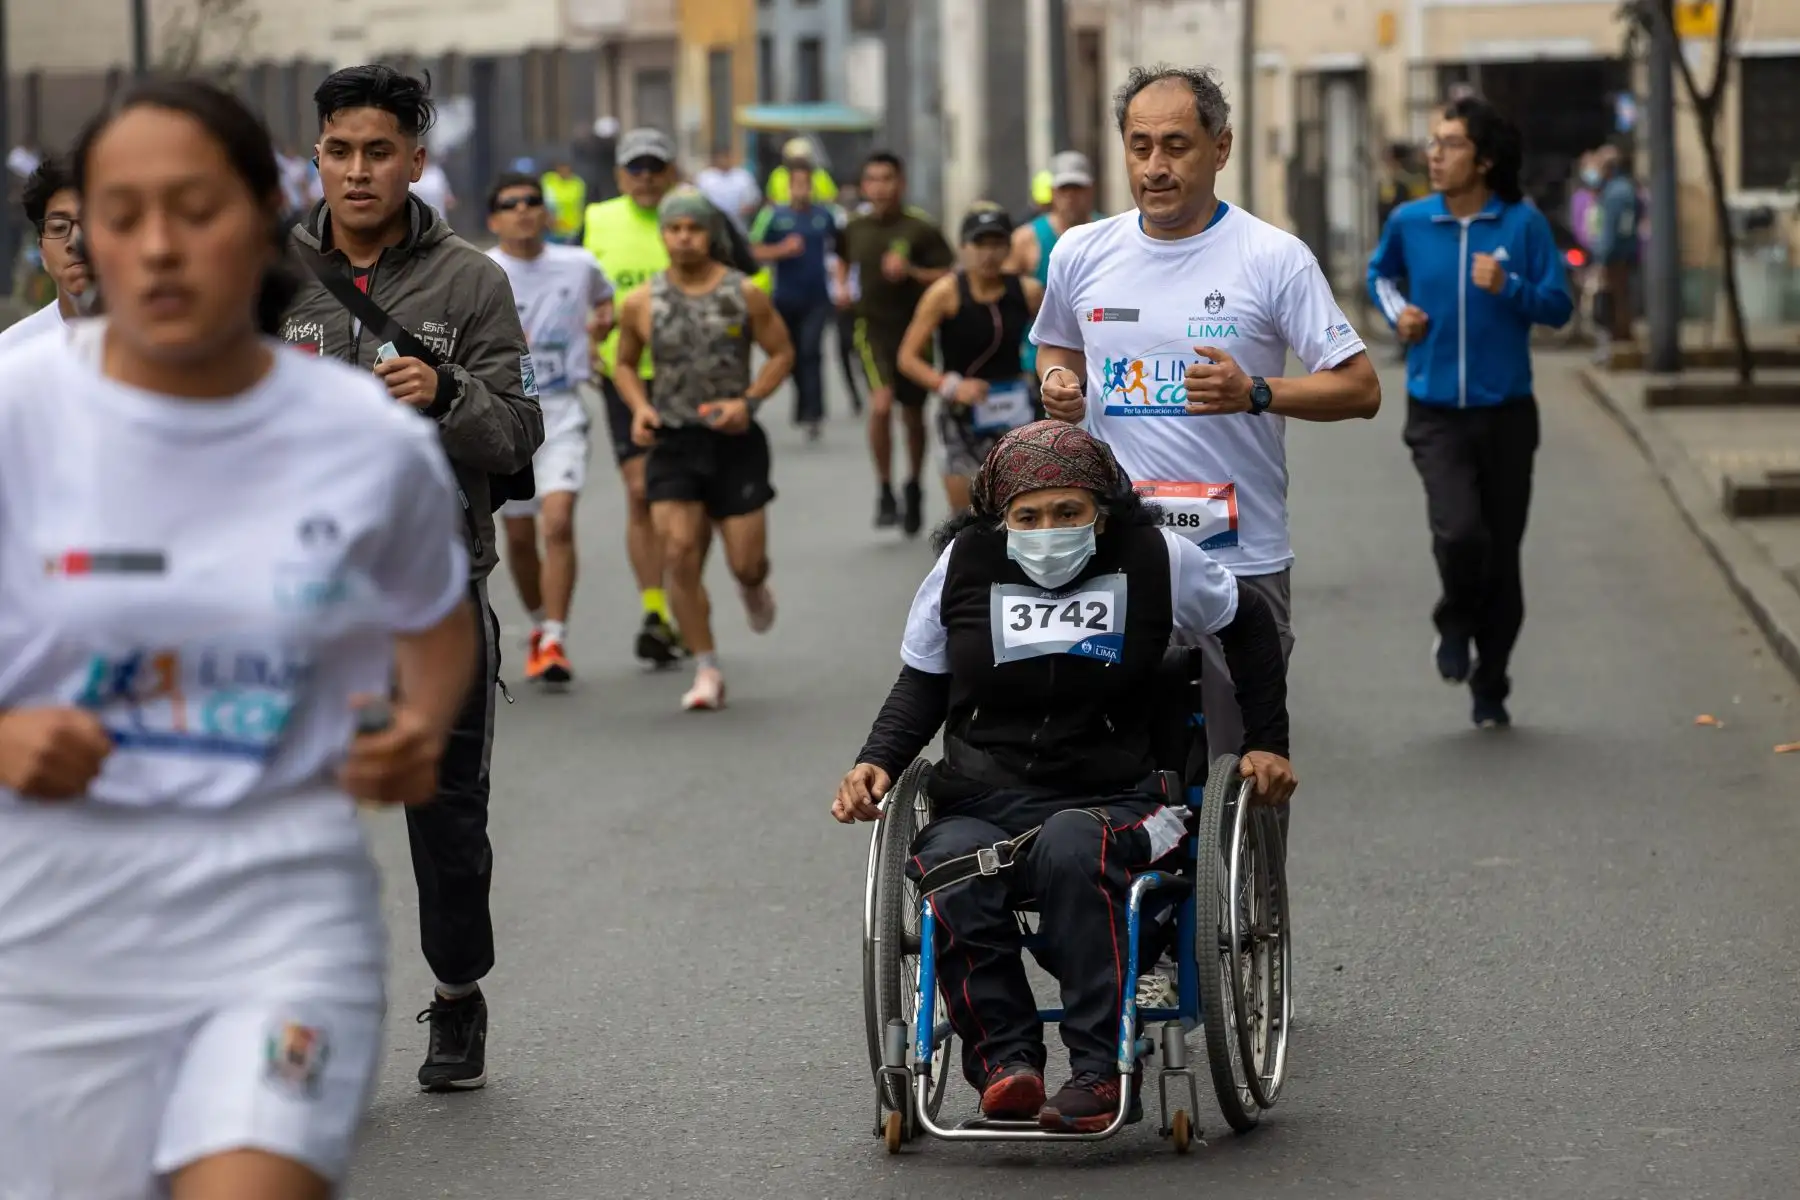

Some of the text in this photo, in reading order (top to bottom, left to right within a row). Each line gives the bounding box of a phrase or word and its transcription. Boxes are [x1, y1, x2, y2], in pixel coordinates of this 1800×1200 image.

[1187, 324, 1239, 338] LIMA
[1142, 407, 1171, 415] donación
[1010, 600, 1108, 632] 3742
[1095, 647, 1117, 659] LIMA
